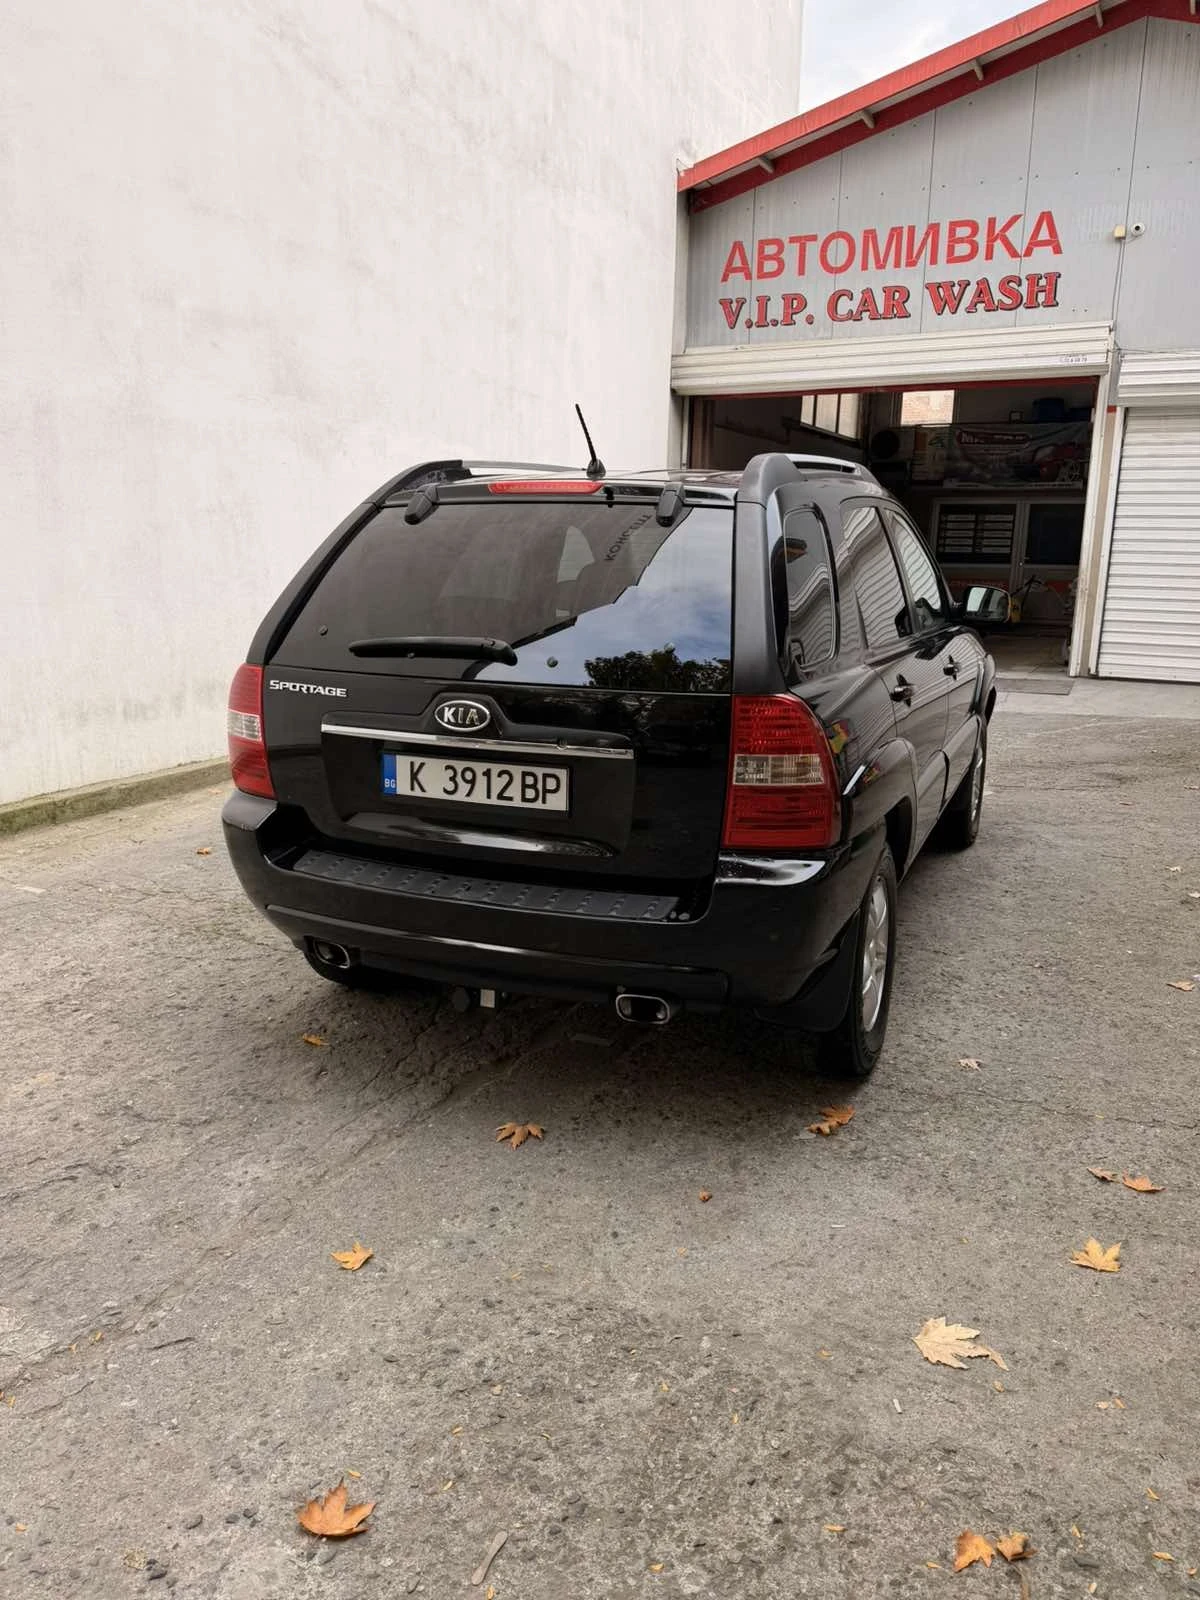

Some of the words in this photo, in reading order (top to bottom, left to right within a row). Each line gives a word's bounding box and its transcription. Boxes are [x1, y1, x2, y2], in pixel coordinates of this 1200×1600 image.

[720, 210, 1064, 283] АВТОМИВКА
[719, 294, 815, 329] V.I.P.
[826, 286, 911, 322] CAR
[925, 272, 1062, 315] WASH
[269, 680, 347, 697] SPORTAGE
[443, 706, 481, 726] KIA
[384, 778, 396, 789] BG
